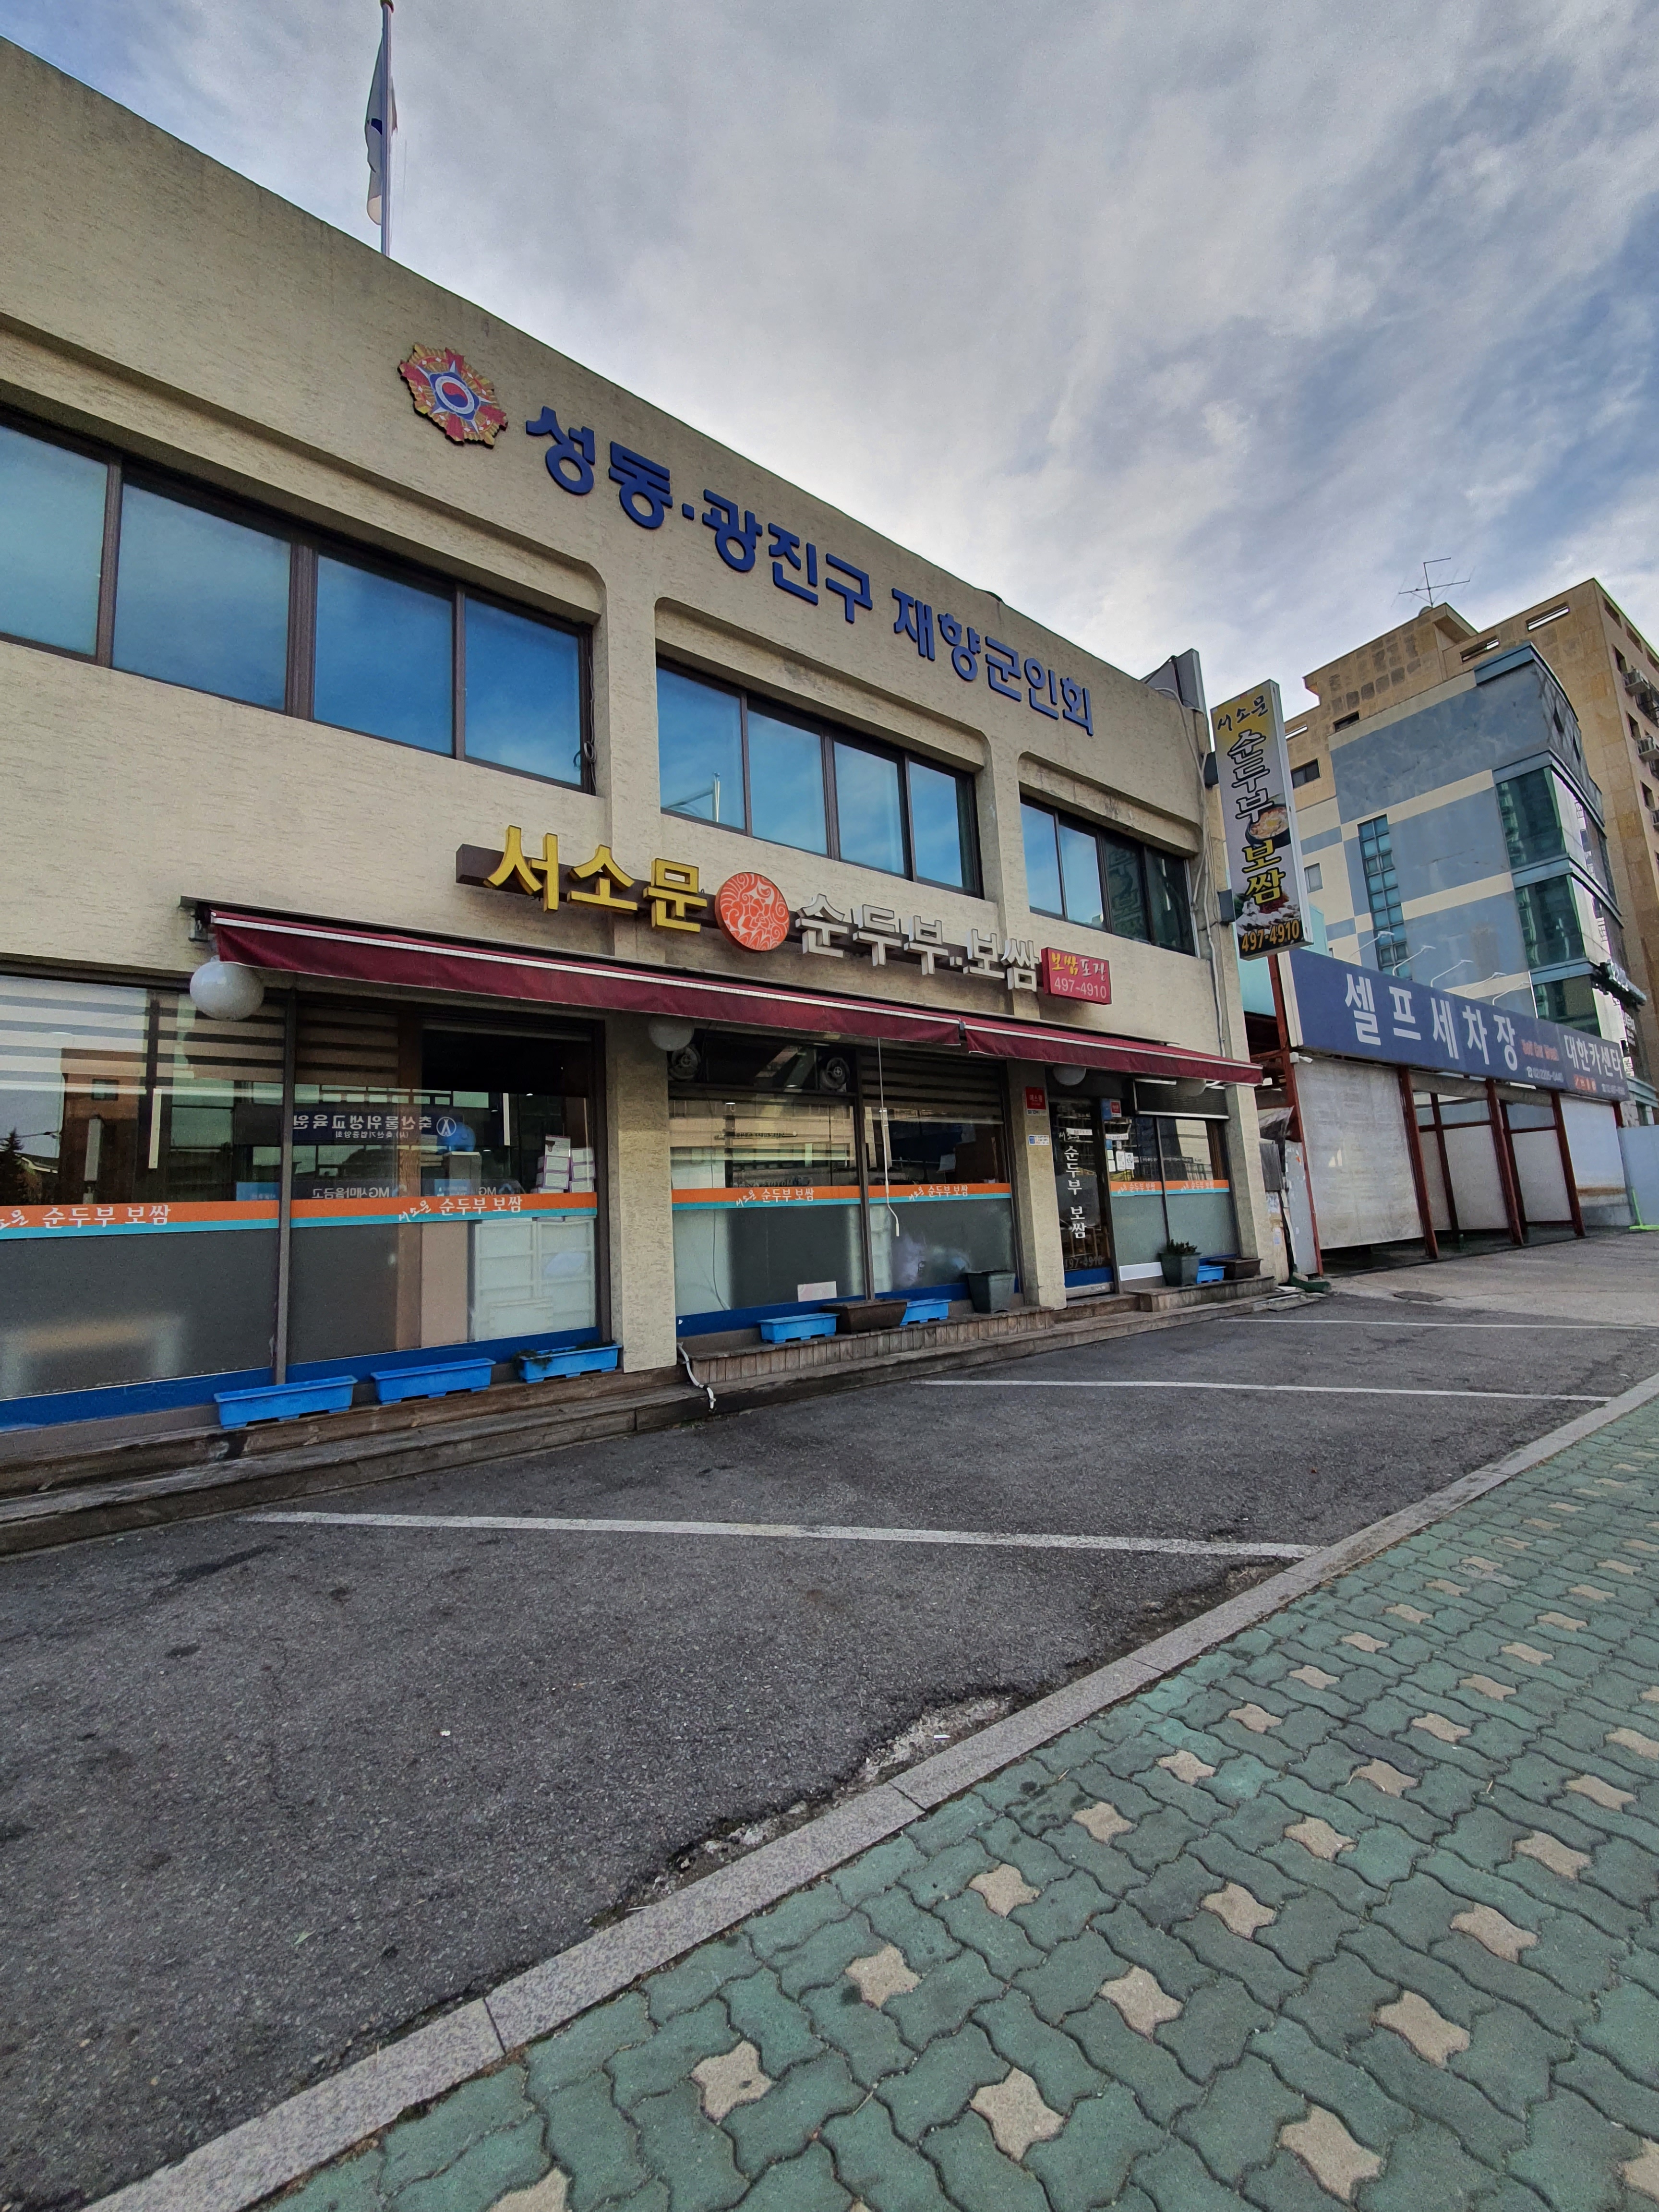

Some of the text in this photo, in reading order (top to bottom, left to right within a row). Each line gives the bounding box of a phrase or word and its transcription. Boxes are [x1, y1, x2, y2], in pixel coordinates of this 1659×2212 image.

[892, 588, 1094, 736] 재향군인회
[1217, 696, 1268, 731] 서소문
[1227, 729, 1274, 823] 순두부
[483, 825, 708, 933] 서소문
[1241, 839, 1286, 905] 보쌈
[1051, 952, 1079, 976] 보쌈
[1054, 976, 1107, 999] 497-4910
[1563, 1034, 1623, 1080] 대한카센타
[1063, 1145, 1083, 1195] 순두부
[439, 1198, 487, 1216] 순두부
[493, 1195, 523, 1213] 보쌈
[761, 1188, 792, 1202] 순두부
[795, 1187, 815, 1202] 보쌈
[928, 1185, 951, 1198] 순두부
[953, 1184, 968, 1197] 보쌈
[42, 1206, 116, 1229] 순두부
[125, 1204, 171, 1226] 보쌈
[1070, 1206, 1087, 1239] 보쌈
